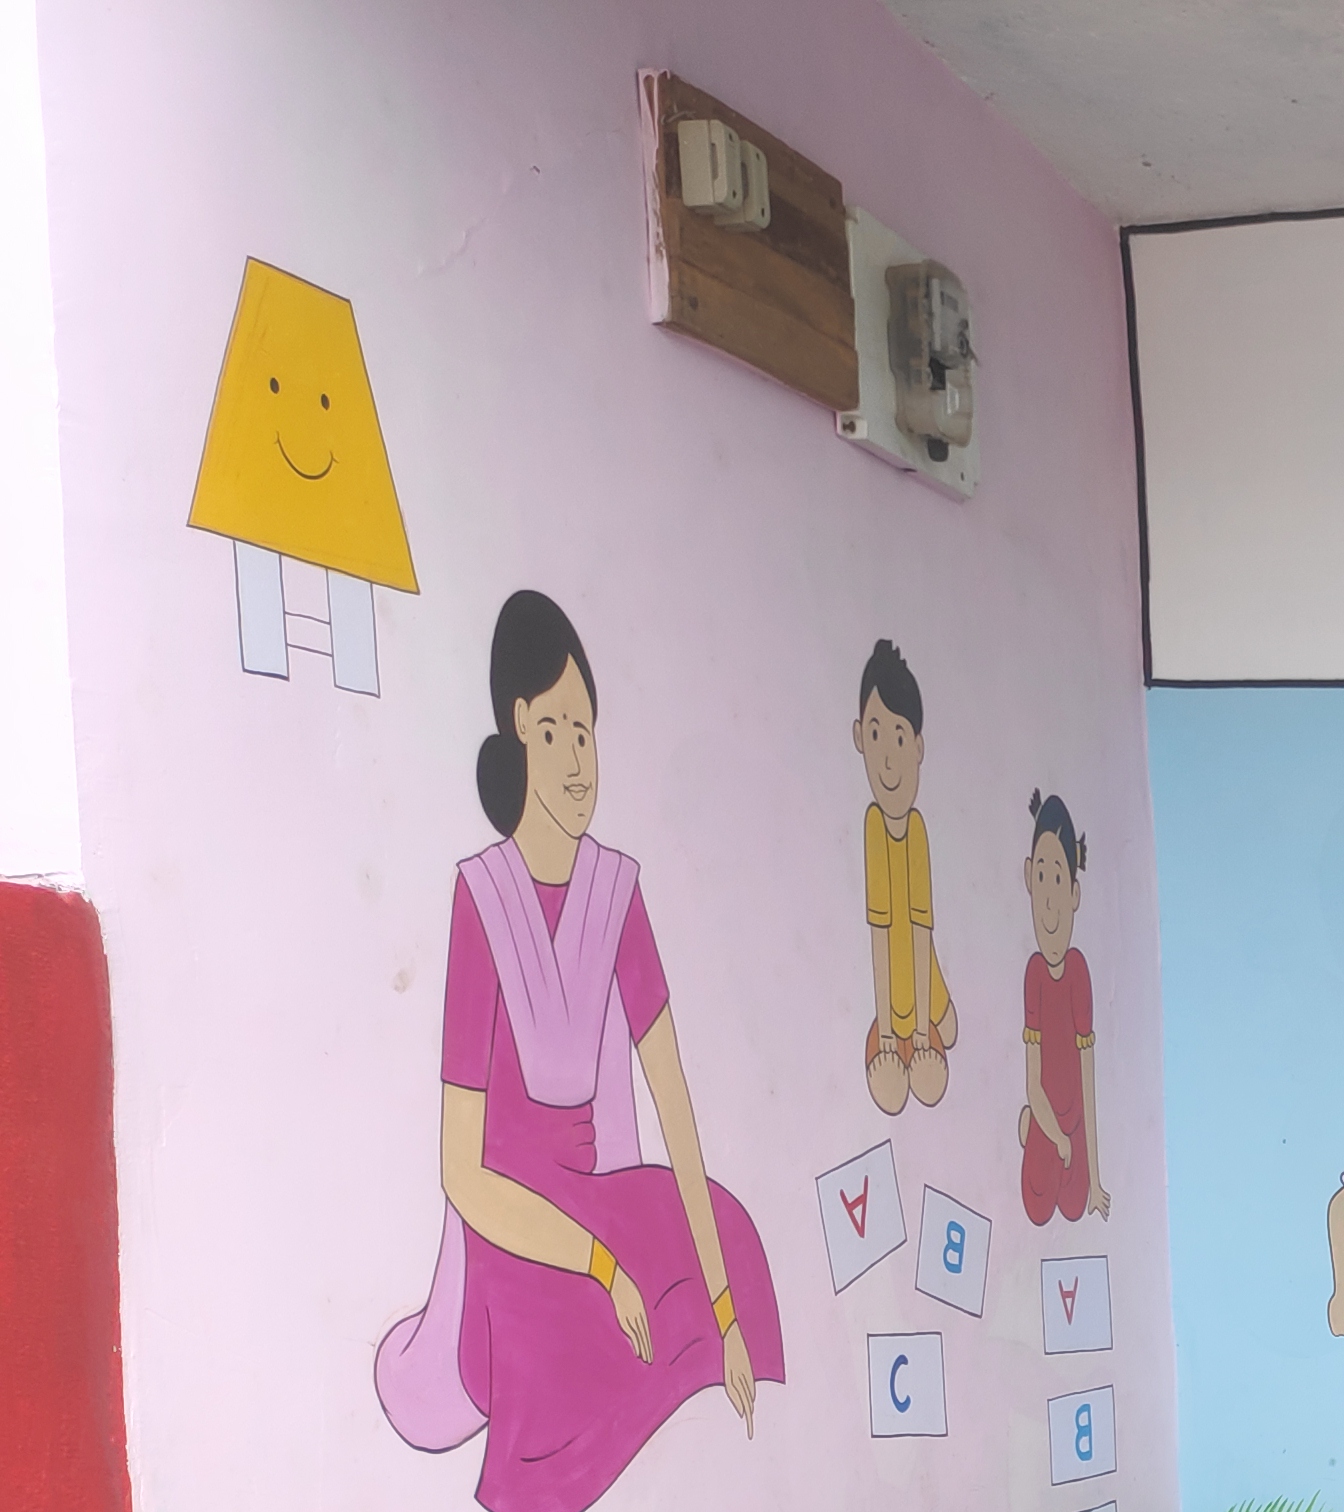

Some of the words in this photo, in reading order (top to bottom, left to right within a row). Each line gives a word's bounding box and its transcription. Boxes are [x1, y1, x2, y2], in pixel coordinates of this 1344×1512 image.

[839, 1175, 869, 1239] A
[942, 1220, 967, 1274] B
[1058, 1276, 1080, 1326] A
[889, 1354, 912, 1414] C
[1074, 1403, 1094, 1463] B
